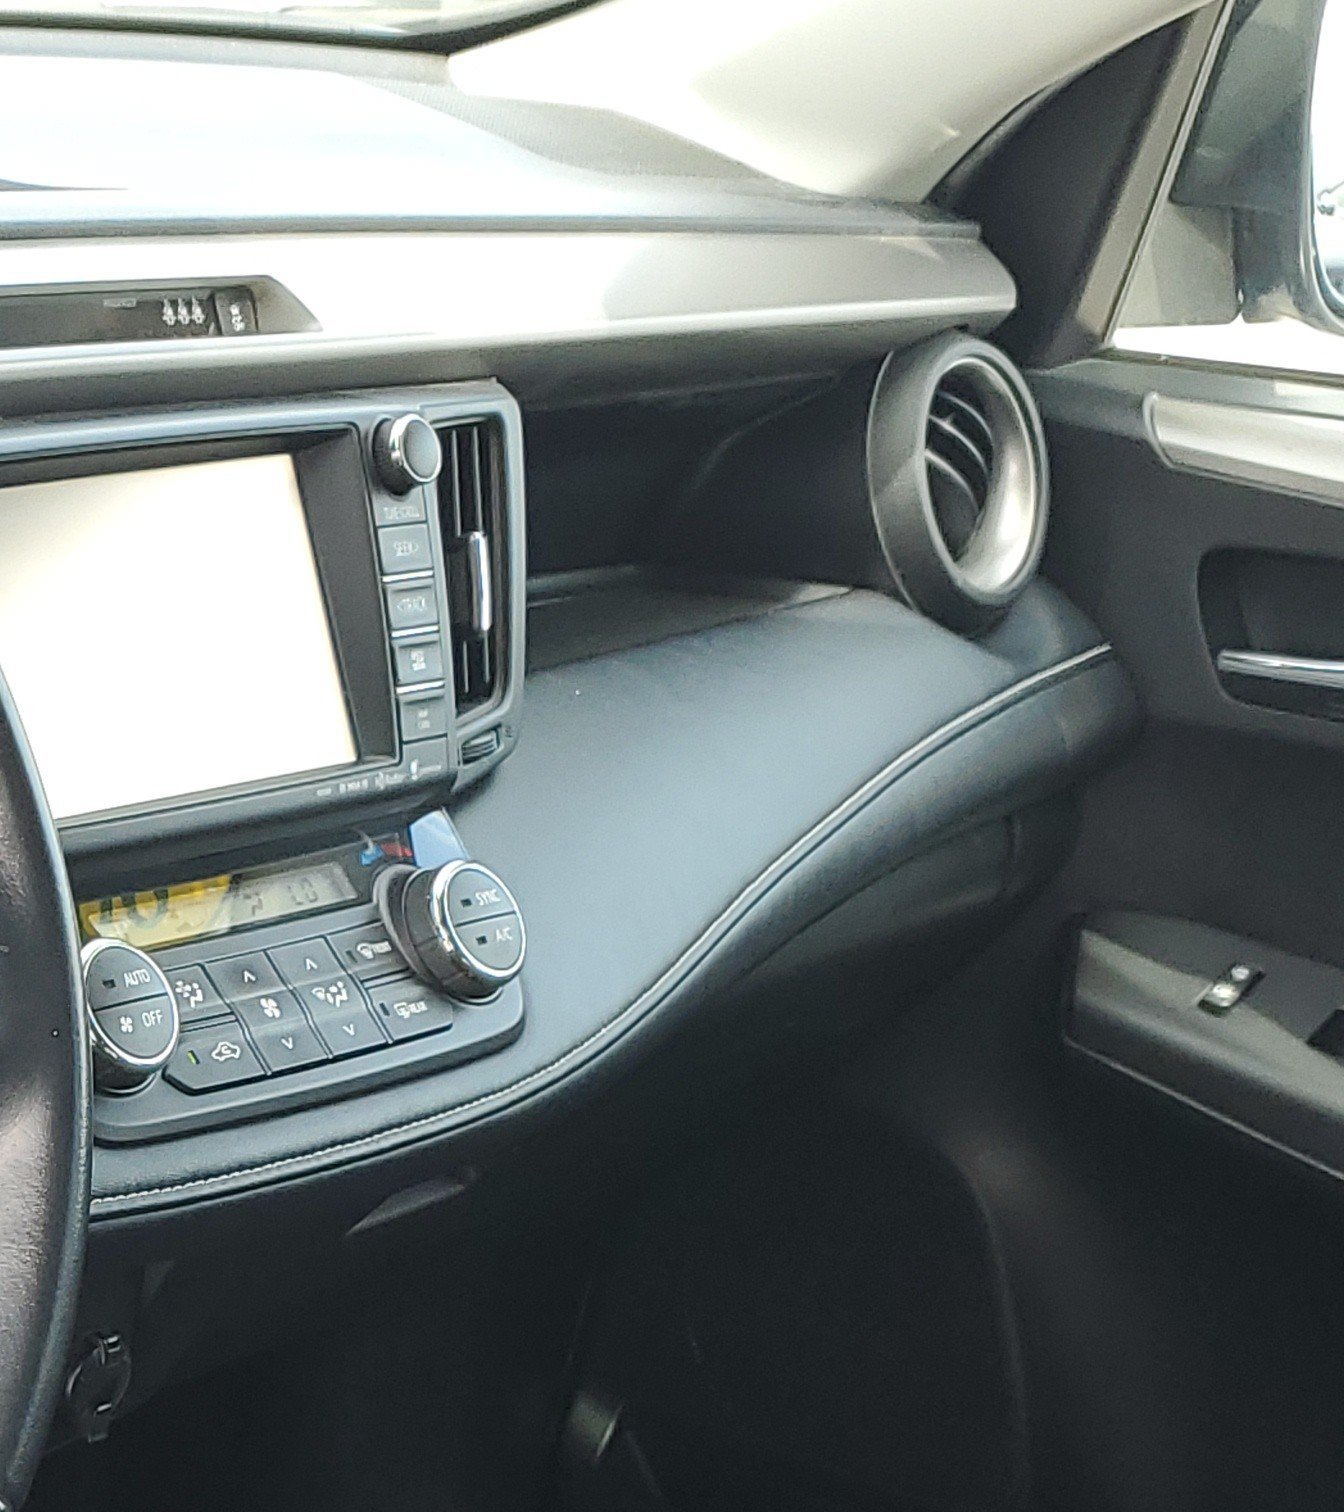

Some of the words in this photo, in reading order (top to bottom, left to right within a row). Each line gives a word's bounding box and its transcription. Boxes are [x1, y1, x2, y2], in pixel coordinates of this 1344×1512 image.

[475, 888, 502, 907] SYNC
[495, 926, 513, 942] A/C
[123, 968, 151, 988] AUTO
[141, 1009, 163, 1029] OFF
